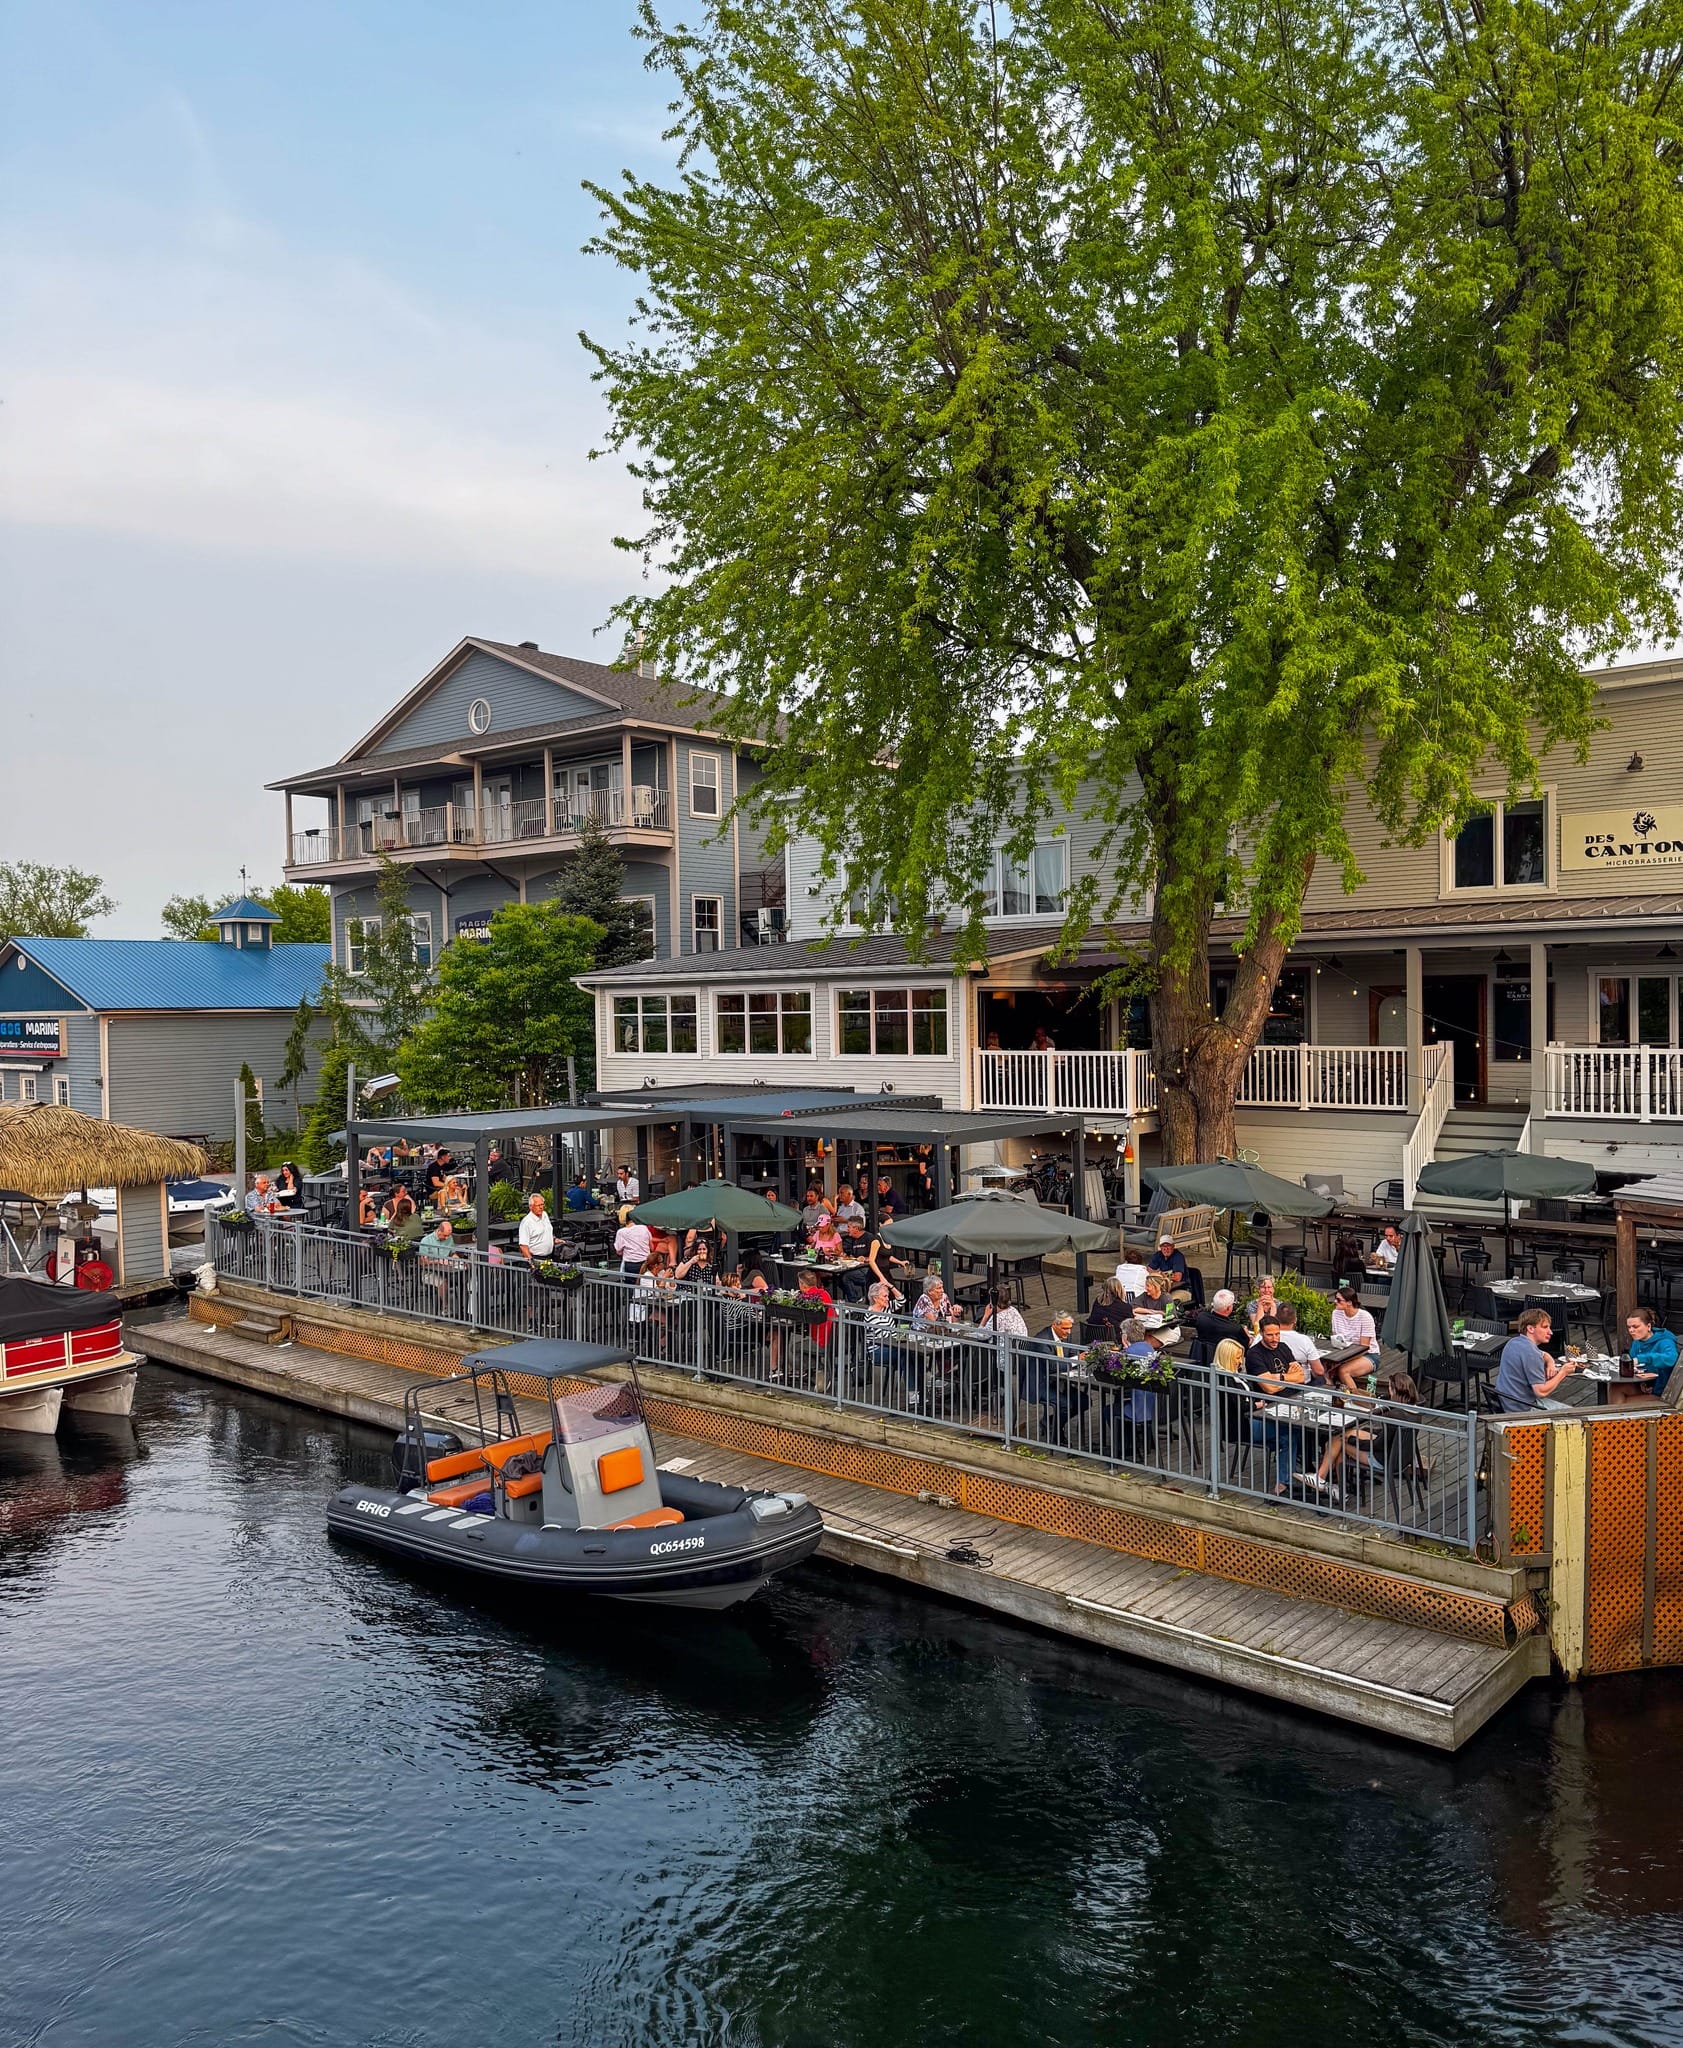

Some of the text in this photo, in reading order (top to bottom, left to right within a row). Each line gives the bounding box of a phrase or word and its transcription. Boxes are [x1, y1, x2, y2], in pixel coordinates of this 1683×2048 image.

[1585, 834, 1615, 844] DES
[1585, 841, 1683, 858] CANTON
[1606, 856, 1683, 866] MICROBRASSERIE
[26, 1022, 59, 1035] MARINE
[356, 1500, 391, 1517] BRIG
[650, 1537, 705, 1555] QC654598
